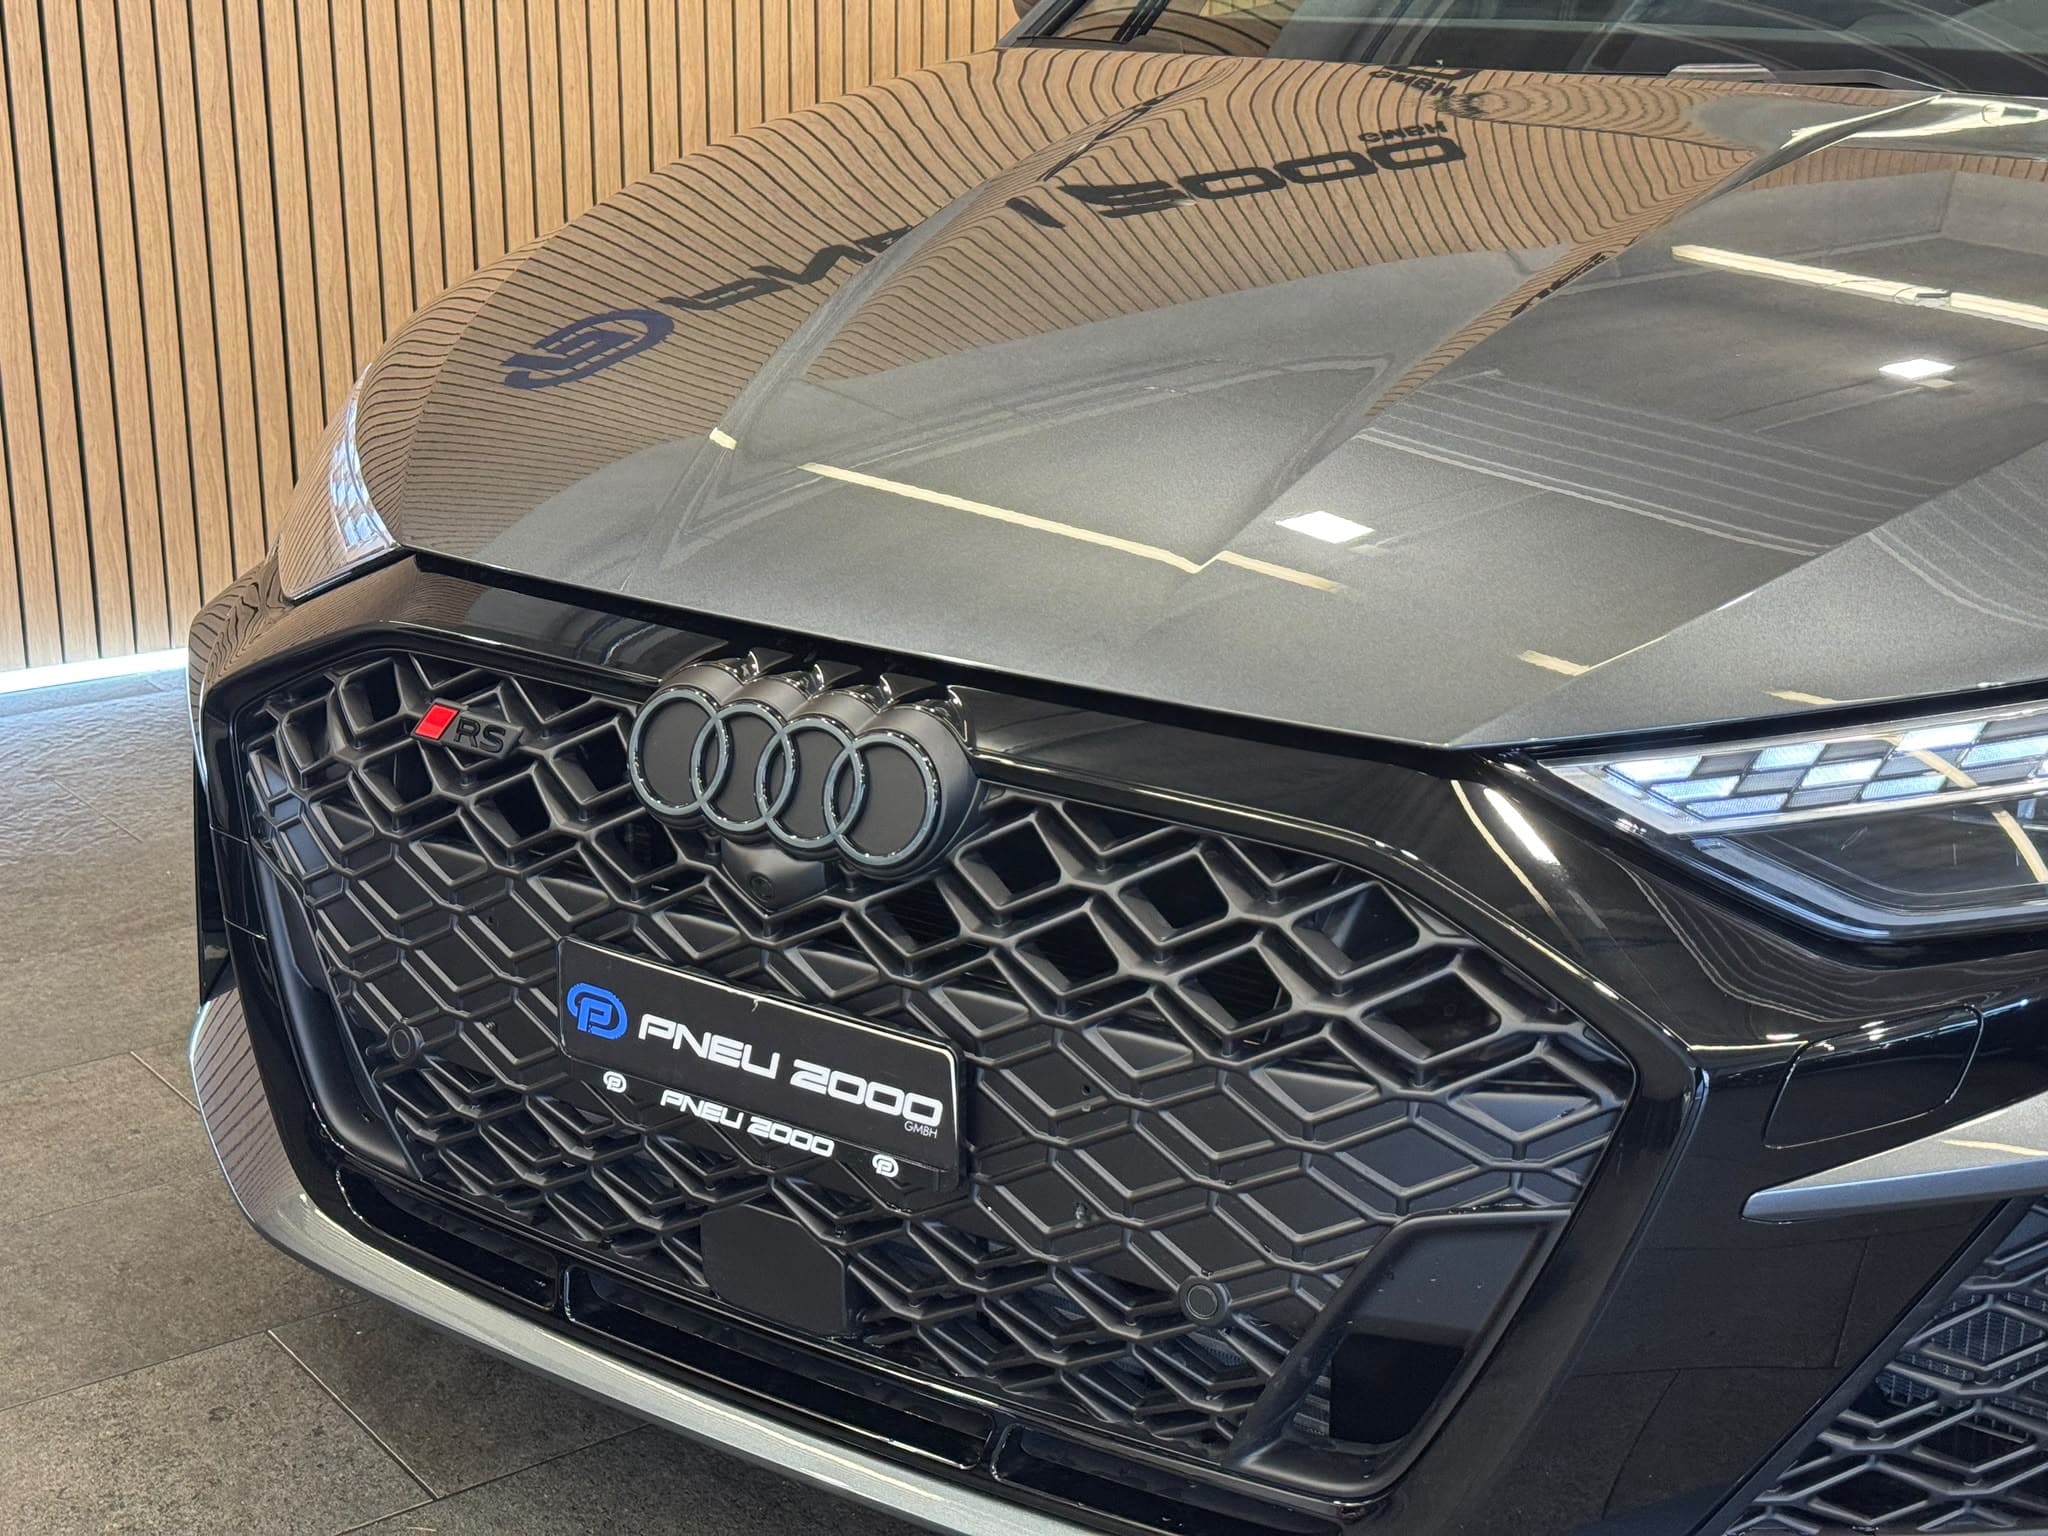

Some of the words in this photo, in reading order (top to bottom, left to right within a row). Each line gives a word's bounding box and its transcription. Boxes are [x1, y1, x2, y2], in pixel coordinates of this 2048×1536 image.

[454, 717, 506, 753] RS
[638, 1013, 780, 1079] PNEU
[790, 1058, 943, 1128] 2000
[660, 1089, 744, 1130] PNEU
[747, 1115, 835, 1158] 2000
[904, 1119, 938, 1139] GMBH
